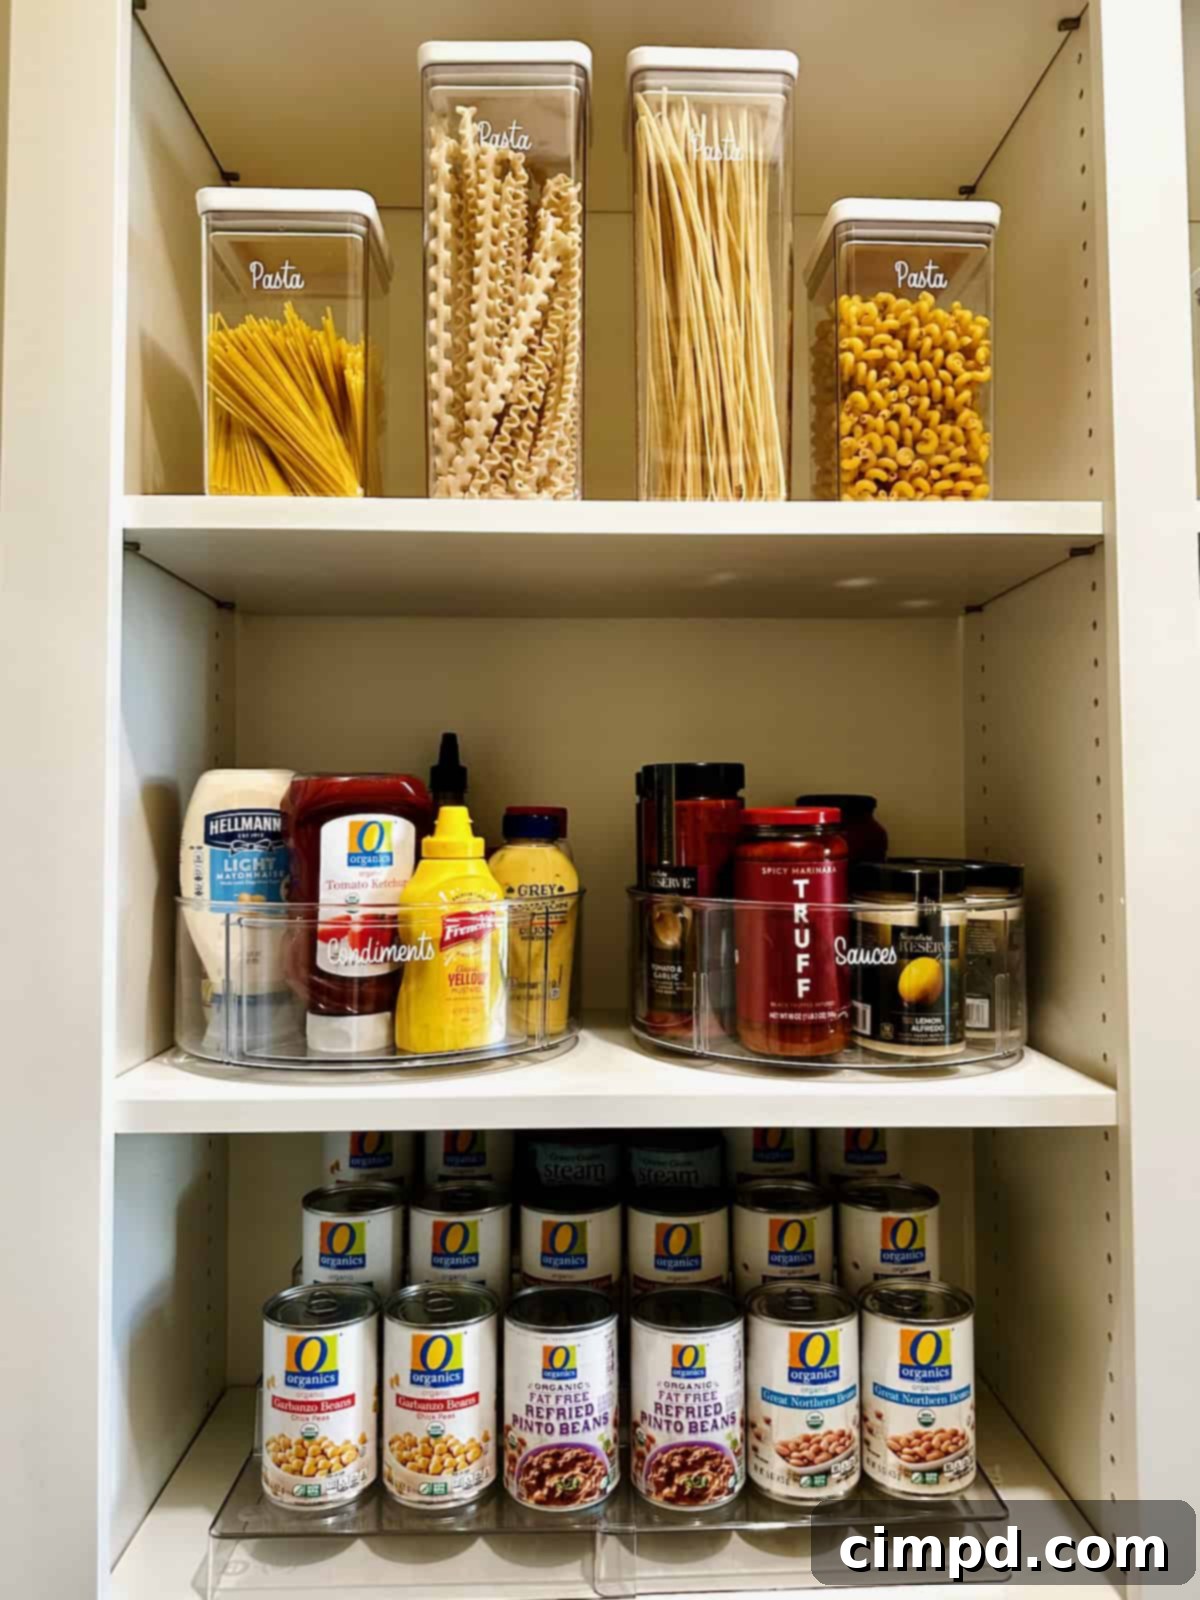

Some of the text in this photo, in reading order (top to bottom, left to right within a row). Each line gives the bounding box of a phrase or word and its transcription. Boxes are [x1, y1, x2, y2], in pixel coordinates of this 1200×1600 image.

[476, 119, 532, 152] Pasta
[689, 128, 743, 160] Pasta
[249, 259, 305, 290] Pasta
[894, 259, 948, 289] Pasta
[209, 815, 282, 836] HELLMANN
[357, 820, 385, 853] O
[223, 857, 276, 872] LIGHT
[349, 854, 391, 866] organics
[761, 866, 837, 876] SPICY MARINARA
[326, 879, 369, 890] Tomato
[517, 883, 557, 897] GREY
[327, 931, 435, 964] Condiments
[792, 878, 811, 999] TRUFF
[833, 936, 898, 966] Sauces
[448, 972, 488, 988] YELLOW
[543, 1161, 606, 1181] steam
[638, 1166, 699, 1186] steam
[327, 1221, 356, 1255] O
[439, 1221, 470, 1255] O
[549, 1221, 578, 1255] O
[663, 1223, 692, 1257] O
[777, 1218, 806, 1252] O
[890, 1217, 918, 1250] O
[320, 1254, 363, 1268] organics
[433, 1254, 477, 1268] organics
[541, 1254, 586, 1269] organics
[655, 1255, 700, 1270] organics
[769, 1251, 813, 1265] organics
[881, 1249, 925, 1263] organics
[294, 1335, 328, 1372] O
[420, 1334, 453, 1371] O
[549, 1344, 570, 1369] O
[677, 1344, 700, 1369] O
[798, 1331, 831, 1369] O
[910, 1330, 942, 1368] O
[286, 1371, 336, 1388] organics
[412, 1370, 461, 1387] organics
[543, 1368, 577, 1379] organics
[672, 1368, 706, 1379] organics
[790, 1368, 838, 1384] organics
[901, 1366, 950, 1383] organics
[534, 1381, 584, 1391] ORGANIC
[663, 1380, 713, 1390] ORGANIC
[273, 1397, 353, 1413] Garbanzo Beans
[397, 1395, 476, 1411] Garbanzo Beans
[529, 1391, 554, 1404] FAT
[555, 1391, 590, 1404] FREE
[657, 1390, 682, 1403] FAT
[684, 1390, 719, 1403] FREE
[762, 1389, 788, 1405] Great
[790, 1396, 836, 1408] Northern
[874, 1385, 899, 1402] Great
[902, 1393, 948, 1406] Northern
[525, 1402, 595, 1421] REFRIED
[654, 1402, 723, 1420] REFRIED
[511, 1412, 610, 1436] PINTO BEANS
[640, 1410, 738, 1434] PINTO BEANS
